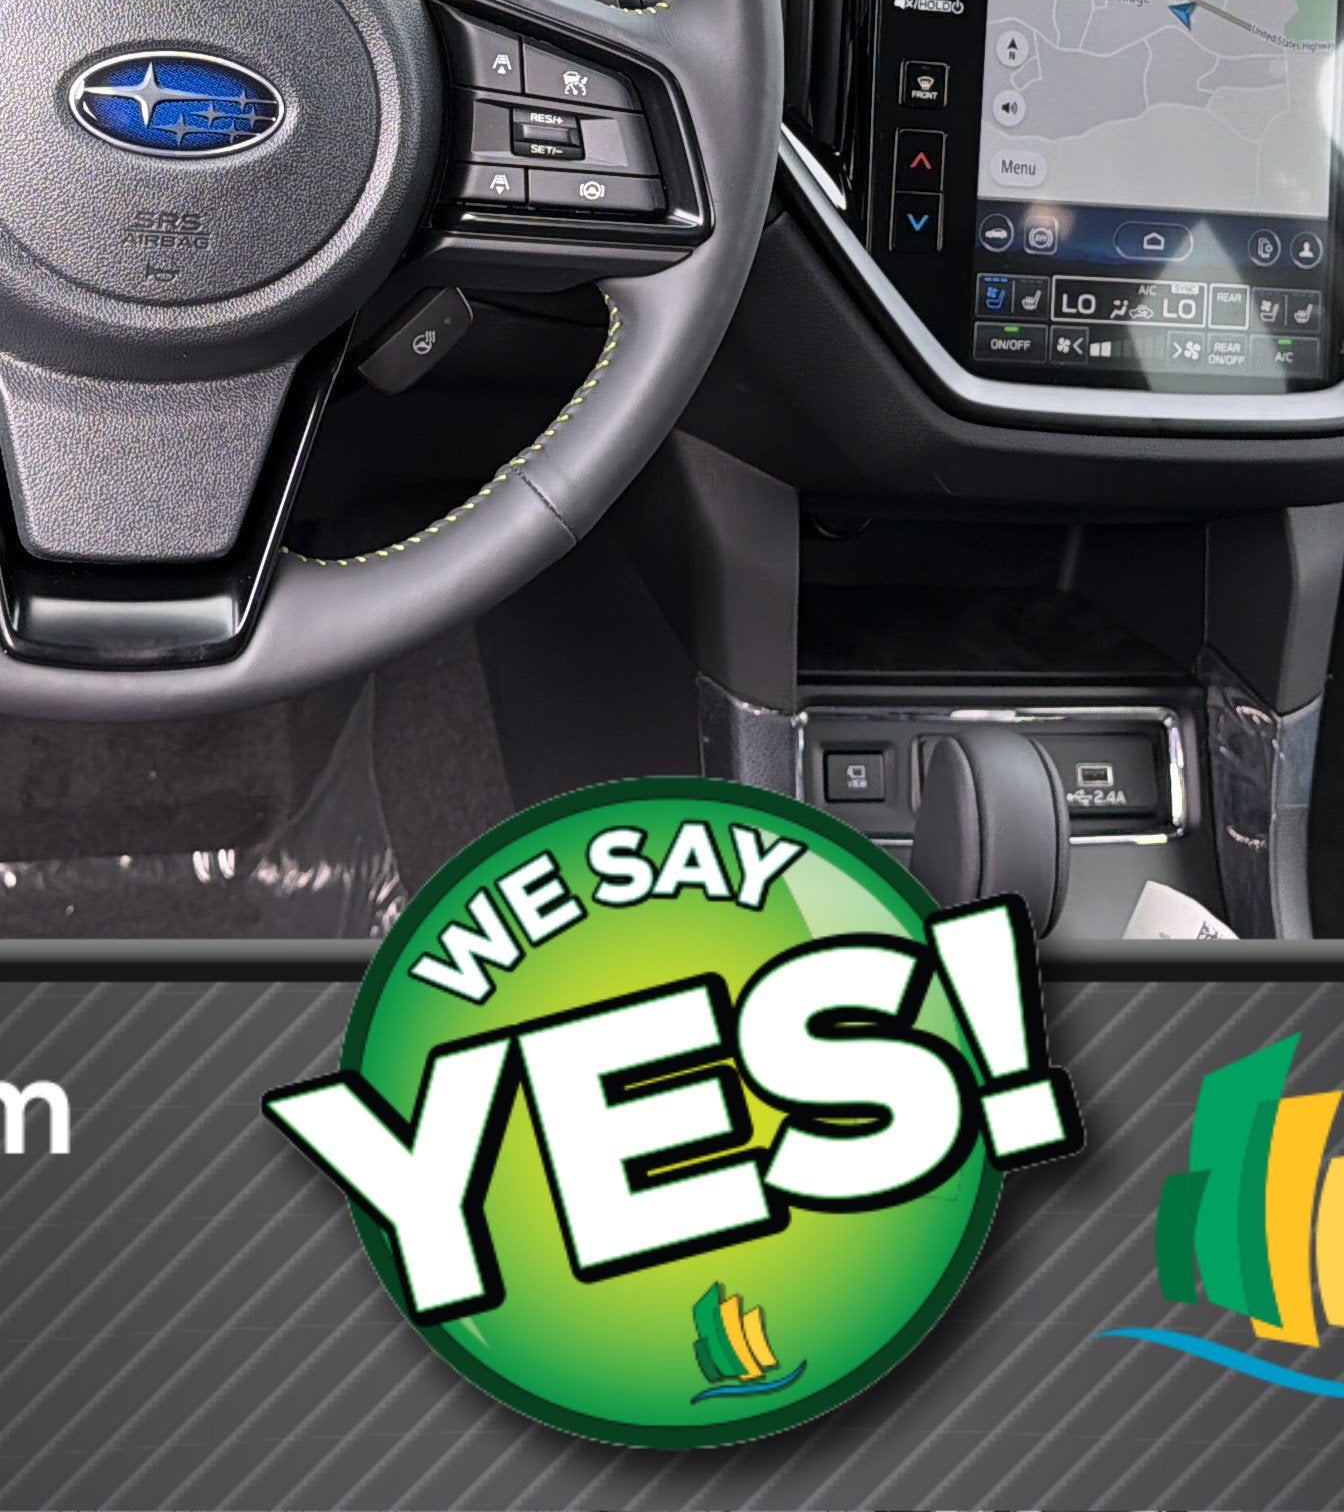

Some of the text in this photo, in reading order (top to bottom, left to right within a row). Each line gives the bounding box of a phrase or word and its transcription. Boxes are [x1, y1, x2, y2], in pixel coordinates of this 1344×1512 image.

[918, 0, 952, 12] HOLD
[1008, 51, 1016, 60] N
[911, 89, 938, 100] FRONT
[1000, 159, 1037, 177] Menu
[132, 212, 204, 231] SRS
[126, 235, 210, 250] AIRBAG
[1138, 284, 1157, 295] A/C
[1062, 293, 1096, 314] LO
[1216, 292, 1242, 303] REAR
[1162, 298, 1196, 319] LO
[990, 338, 1031, 352] ON/OFF
[1213, 342, 1241, 353] REAR
[1208, 353, 1246, 365] ON/OFF
[1274, 352, 1294, 363] A/C
[1093, 790, 1127, 805] 2.4A
